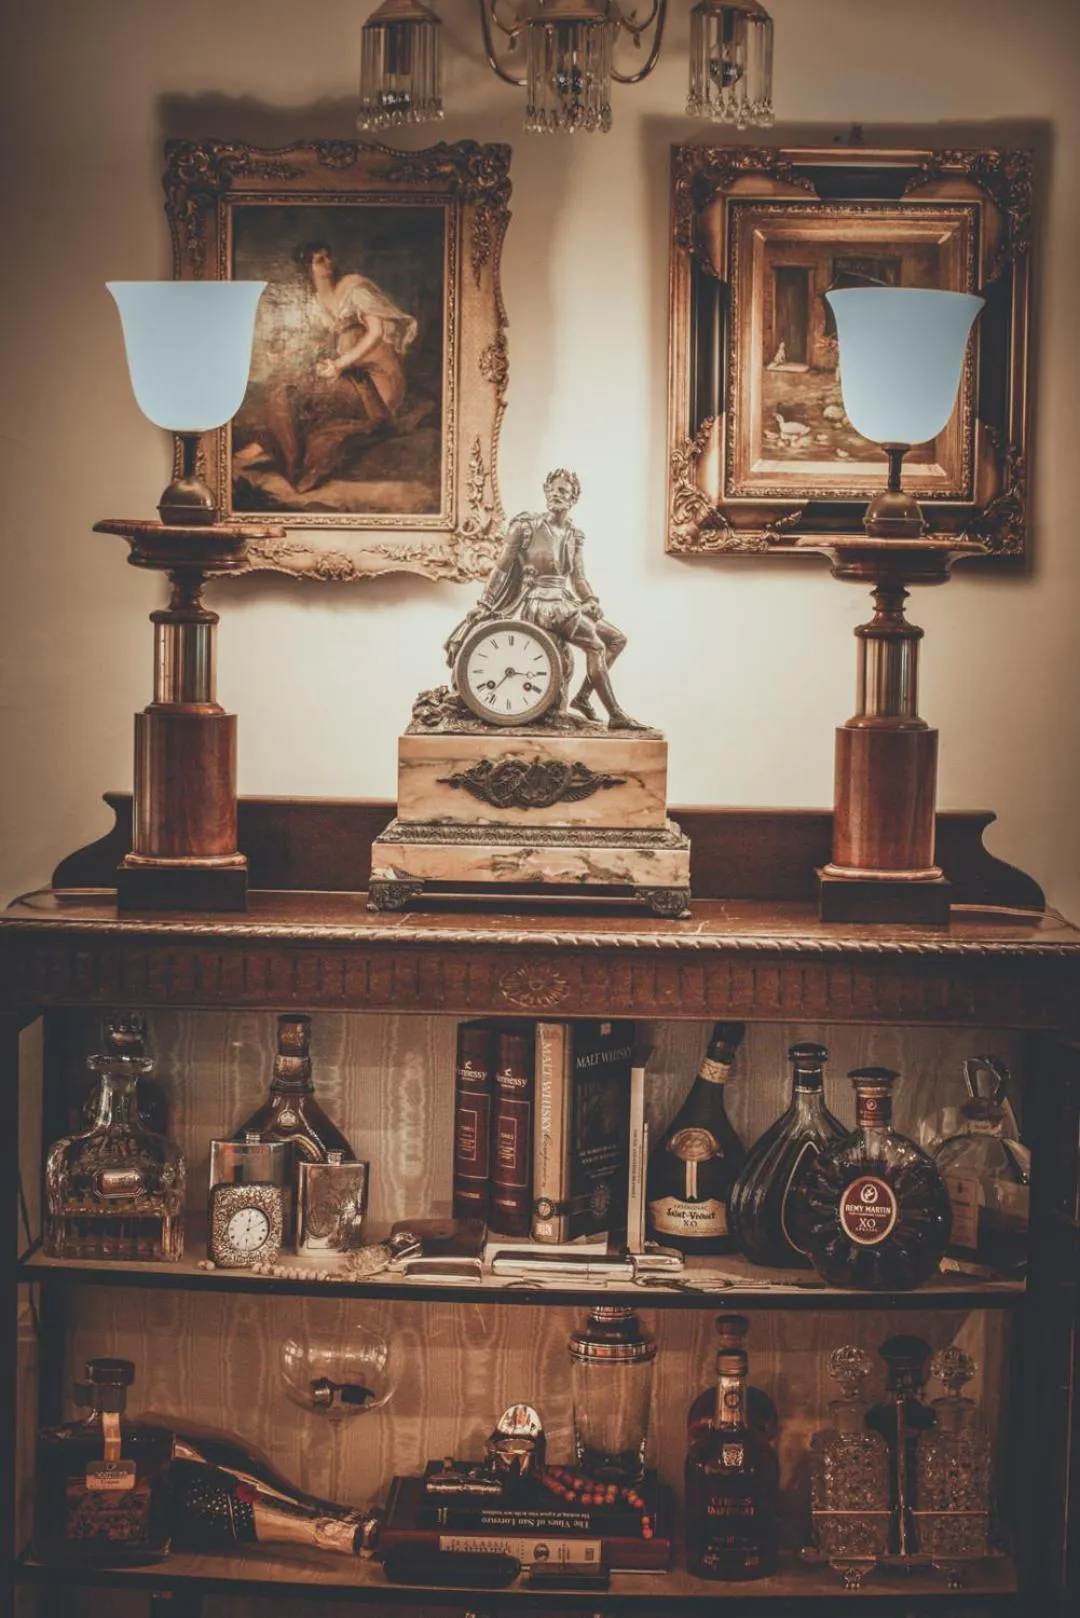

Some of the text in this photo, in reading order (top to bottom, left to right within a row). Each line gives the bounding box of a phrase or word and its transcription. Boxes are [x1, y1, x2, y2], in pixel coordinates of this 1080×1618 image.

[542, 1041, 553, 1078] MALT
[576, 1052, 601, 1069] MALT
[456, 1067, 488, 1081] ennessy
[541, 1080, 552, 1131] WHISKY
[859, 1217, 876, 1228] XO
